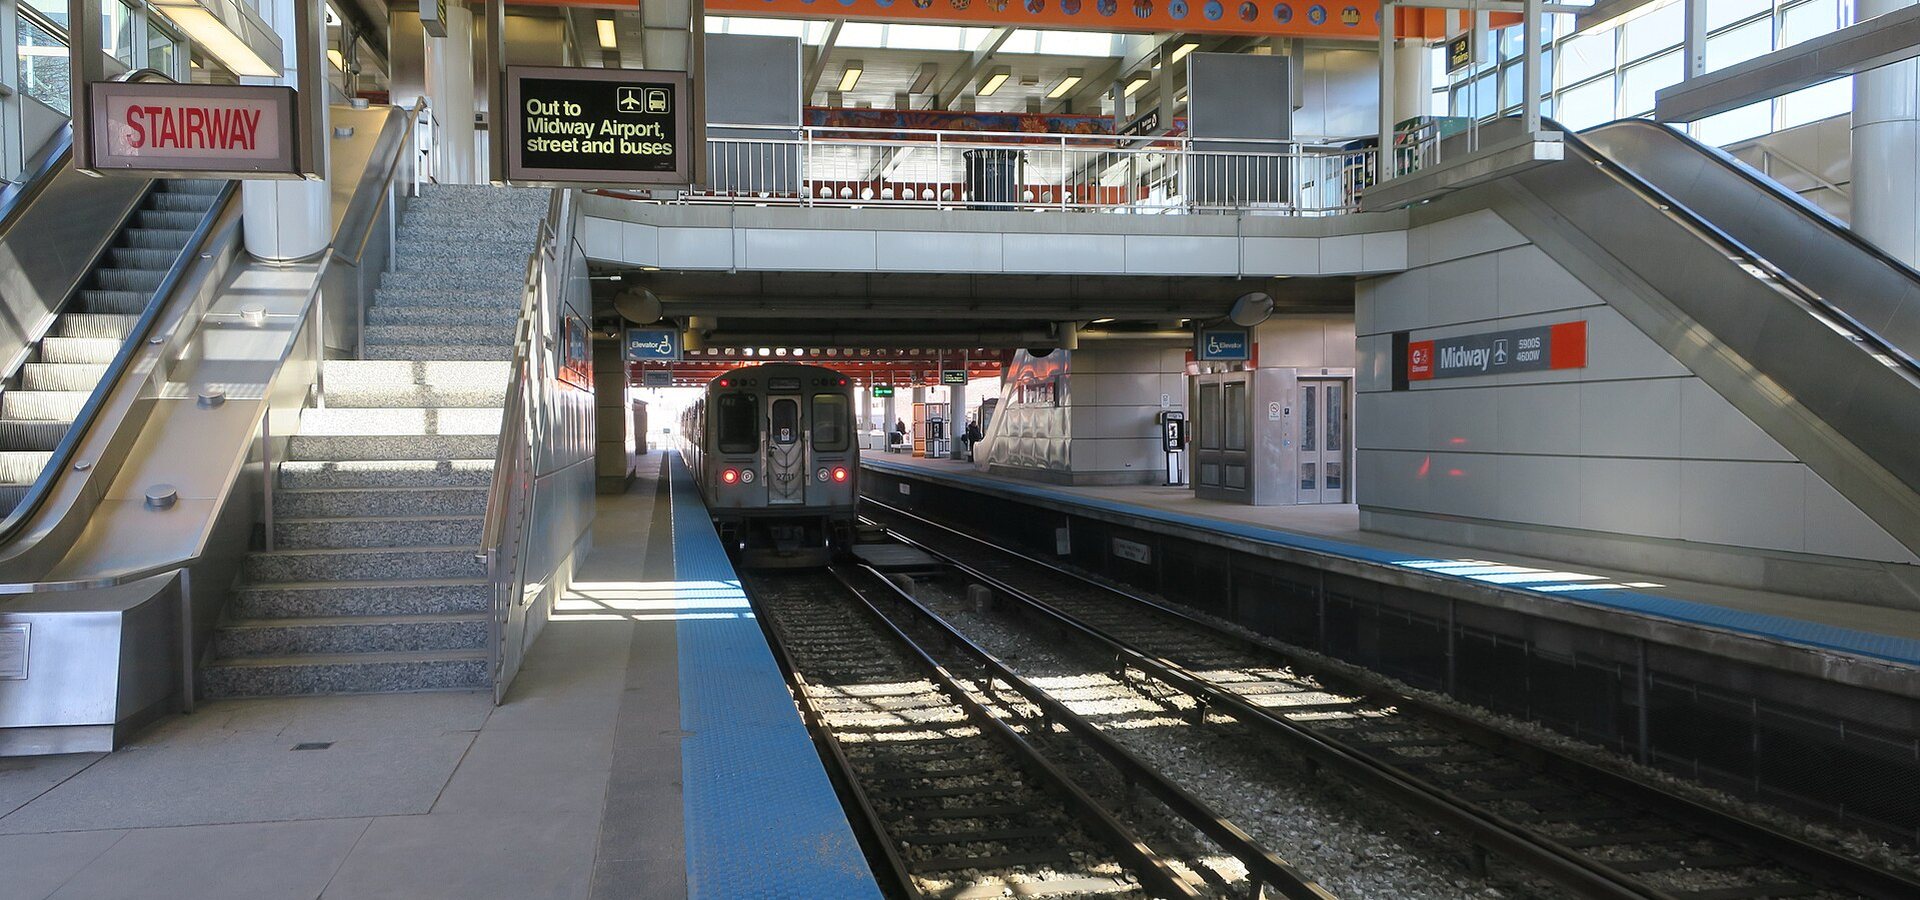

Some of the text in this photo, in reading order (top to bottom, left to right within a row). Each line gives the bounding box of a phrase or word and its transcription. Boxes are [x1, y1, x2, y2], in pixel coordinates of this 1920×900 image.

[526, 98, 582, 117] Out to
[126, 105, 261, 150] STAIRWAY
[527, 117, 665, 140] Midway Airport,
[527, 136, 673, 155] street and buses
[1518, 337, 1541, 349] 5900S
[1441, 345, 1490, 371] Midway
[1516, 350, 1541, 362] 4600W
[776, 473, 795, 481] 2711
